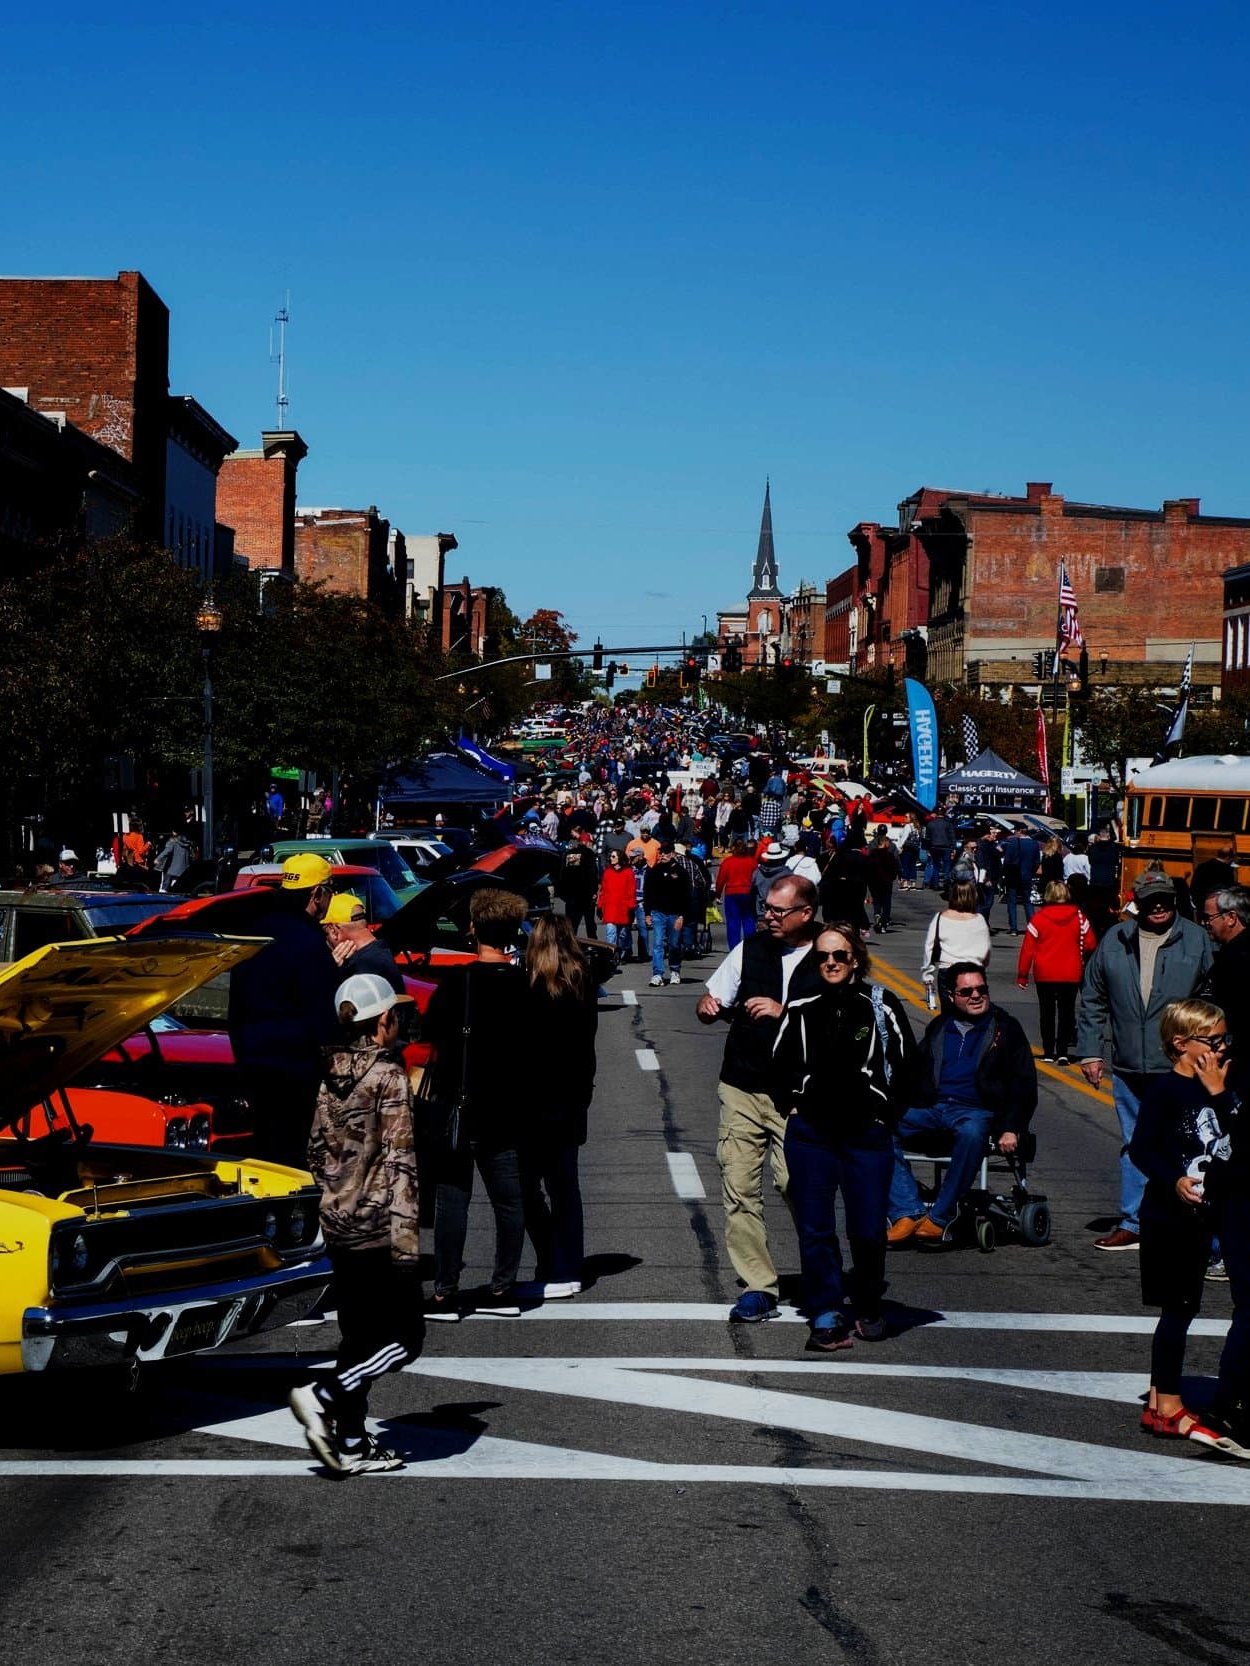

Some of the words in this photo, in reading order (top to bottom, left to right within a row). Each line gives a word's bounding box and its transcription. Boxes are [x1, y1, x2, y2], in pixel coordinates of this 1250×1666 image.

[915, 709, 934, 787] HAGERTY
[960, 769, 1019, 781] HAGERTY
[948, 783, 977, 794] Classic
[978, 784, 994, 794] Car
[995, 785, 1036, 795] Insurance
